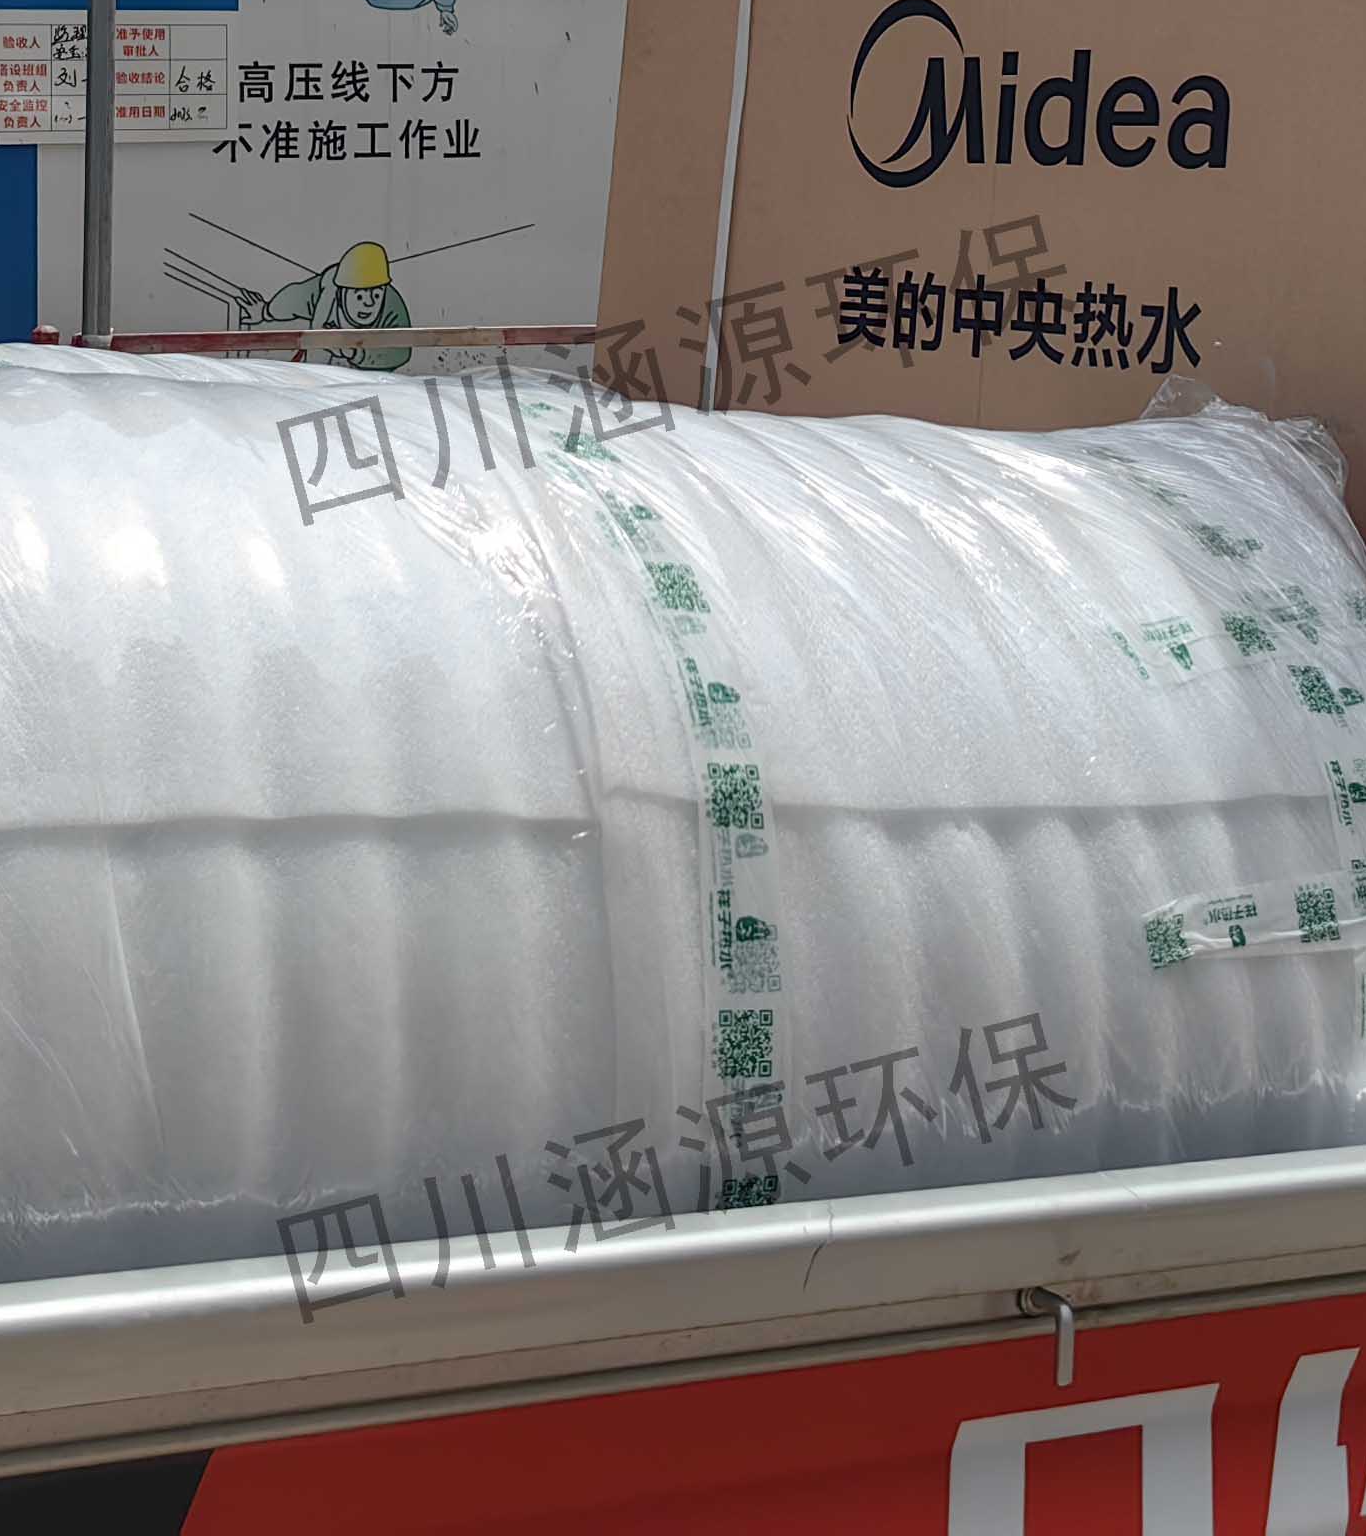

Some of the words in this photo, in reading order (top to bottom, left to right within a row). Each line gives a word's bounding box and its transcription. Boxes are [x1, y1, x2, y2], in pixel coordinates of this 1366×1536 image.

[116, 27, 166, 41] 准予使用
[2, 35, 41, 50] 验收人
[122, 44, 160, 57] 审批人
[116, 71, 166, 85] 验收结论
[174, 65, 217, 93] 合格
[238, 60, 460, 105] 高压线下方
[3, 80, 41, 94] 负责人
[116, 105, 166, 119] 准用日期
[3, 115, 42, 129] 负责人
[212, 118, 483, 163] 不准施工作业
[837, 265, 1202, 374] 美的中央热水
